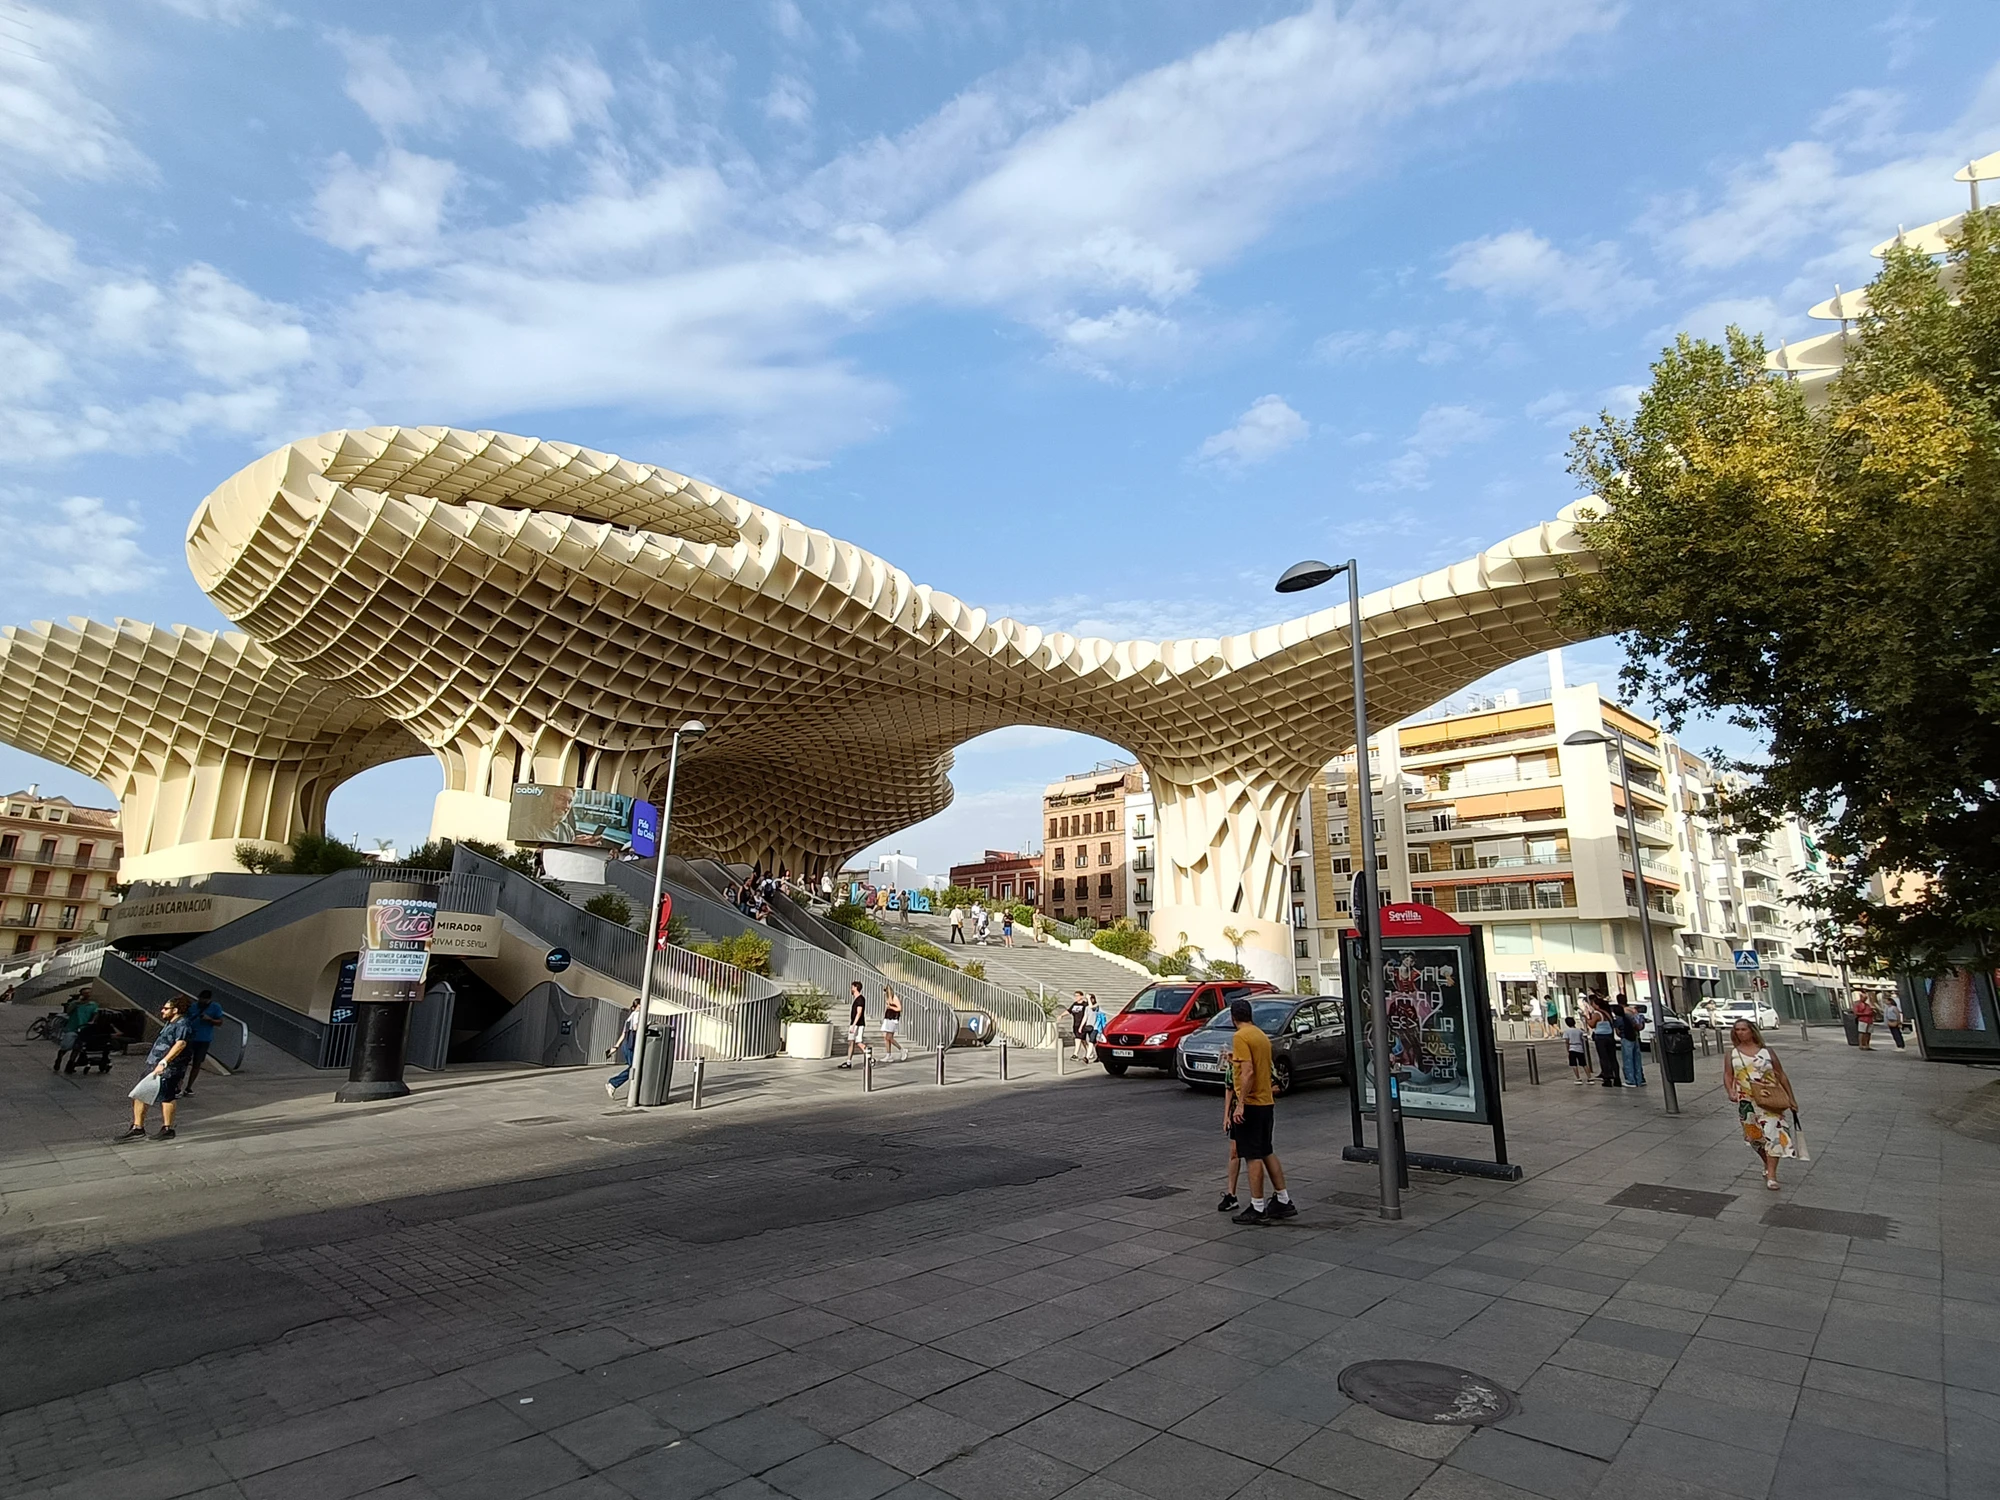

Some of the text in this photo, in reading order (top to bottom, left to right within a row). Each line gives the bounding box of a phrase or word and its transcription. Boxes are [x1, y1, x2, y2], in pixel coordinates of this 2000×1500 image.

[515, 786, 544, 797] cabify
[374, 905, 435, 940] Ruta
[437, 921, 482, 932] MIRADOR
[389, 940, 418, 950] SEVILLA
[455, 938, 465, 947] DE
[466, 939, 488, 949] SEVILLA
